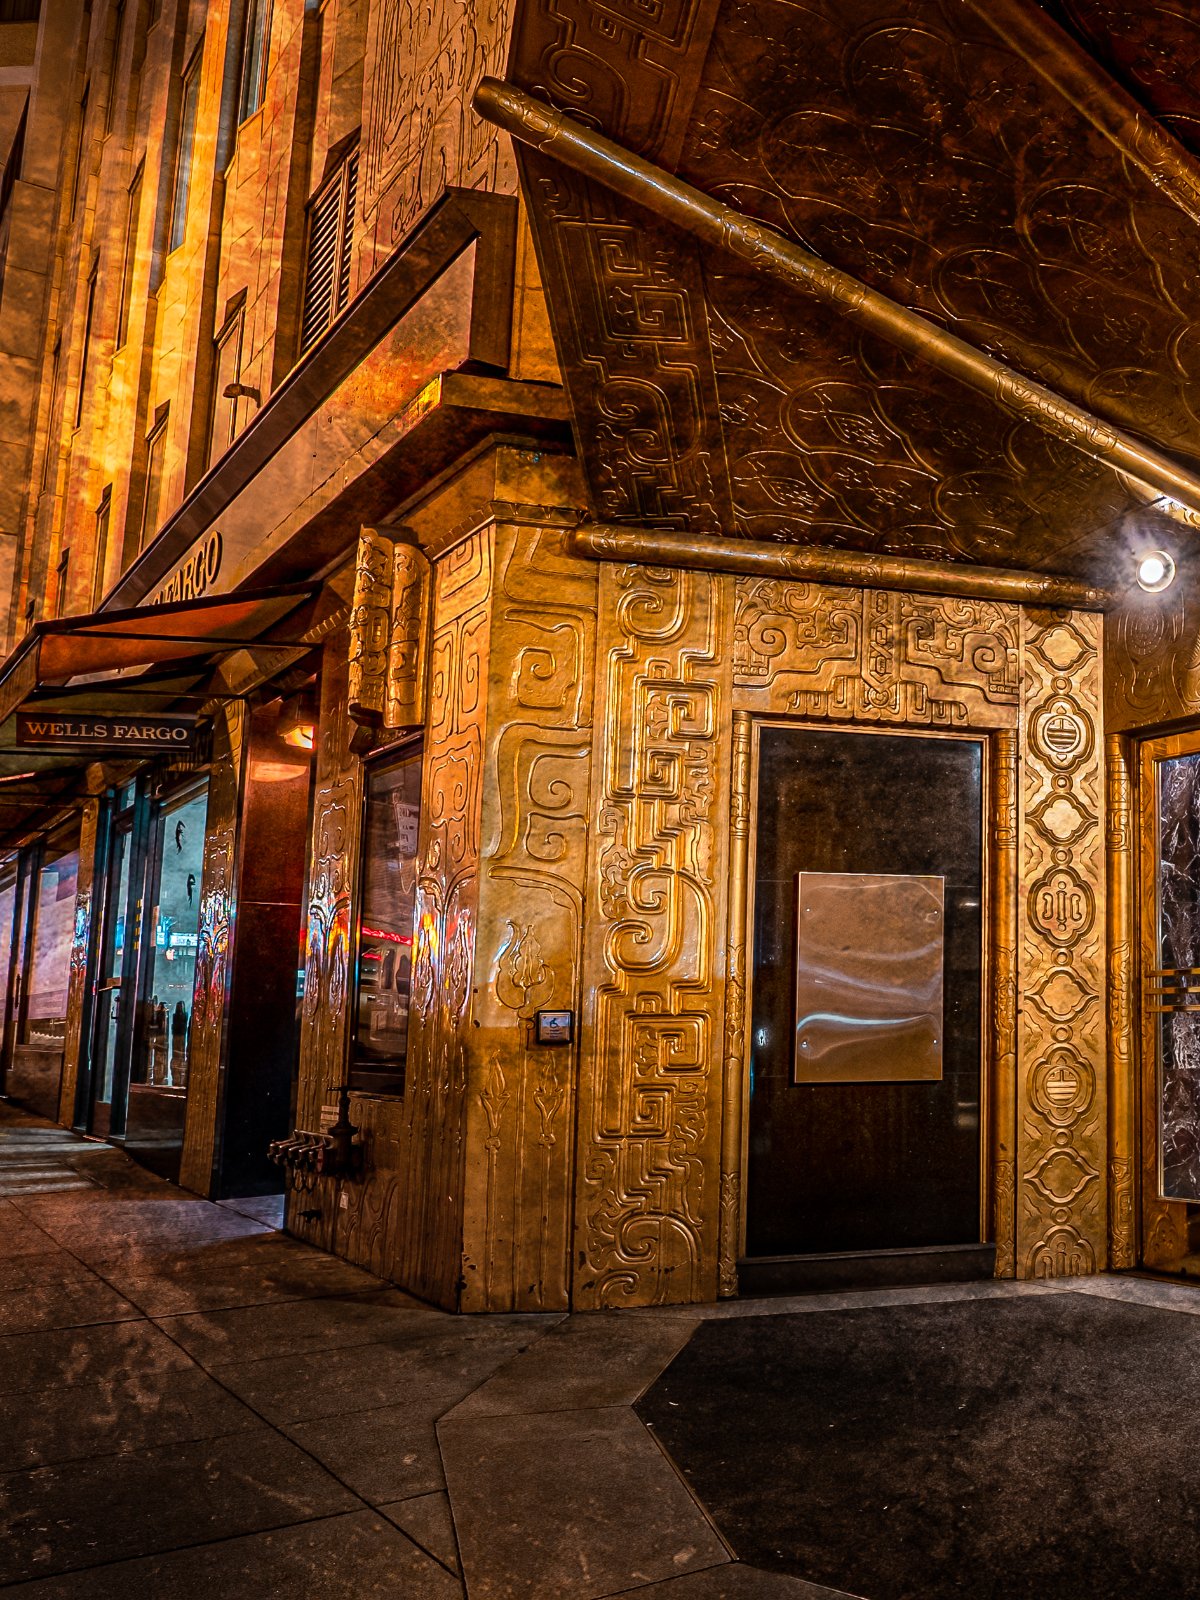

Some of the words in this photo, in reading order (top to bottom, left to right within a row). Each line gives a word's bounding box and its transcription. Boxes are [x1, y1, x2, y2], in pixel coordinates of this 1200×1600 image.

[164, 530, 223, 602] FARGO
[26, 721, 108, 738] WELLS
[112, 724, 188, 741] FARGO
